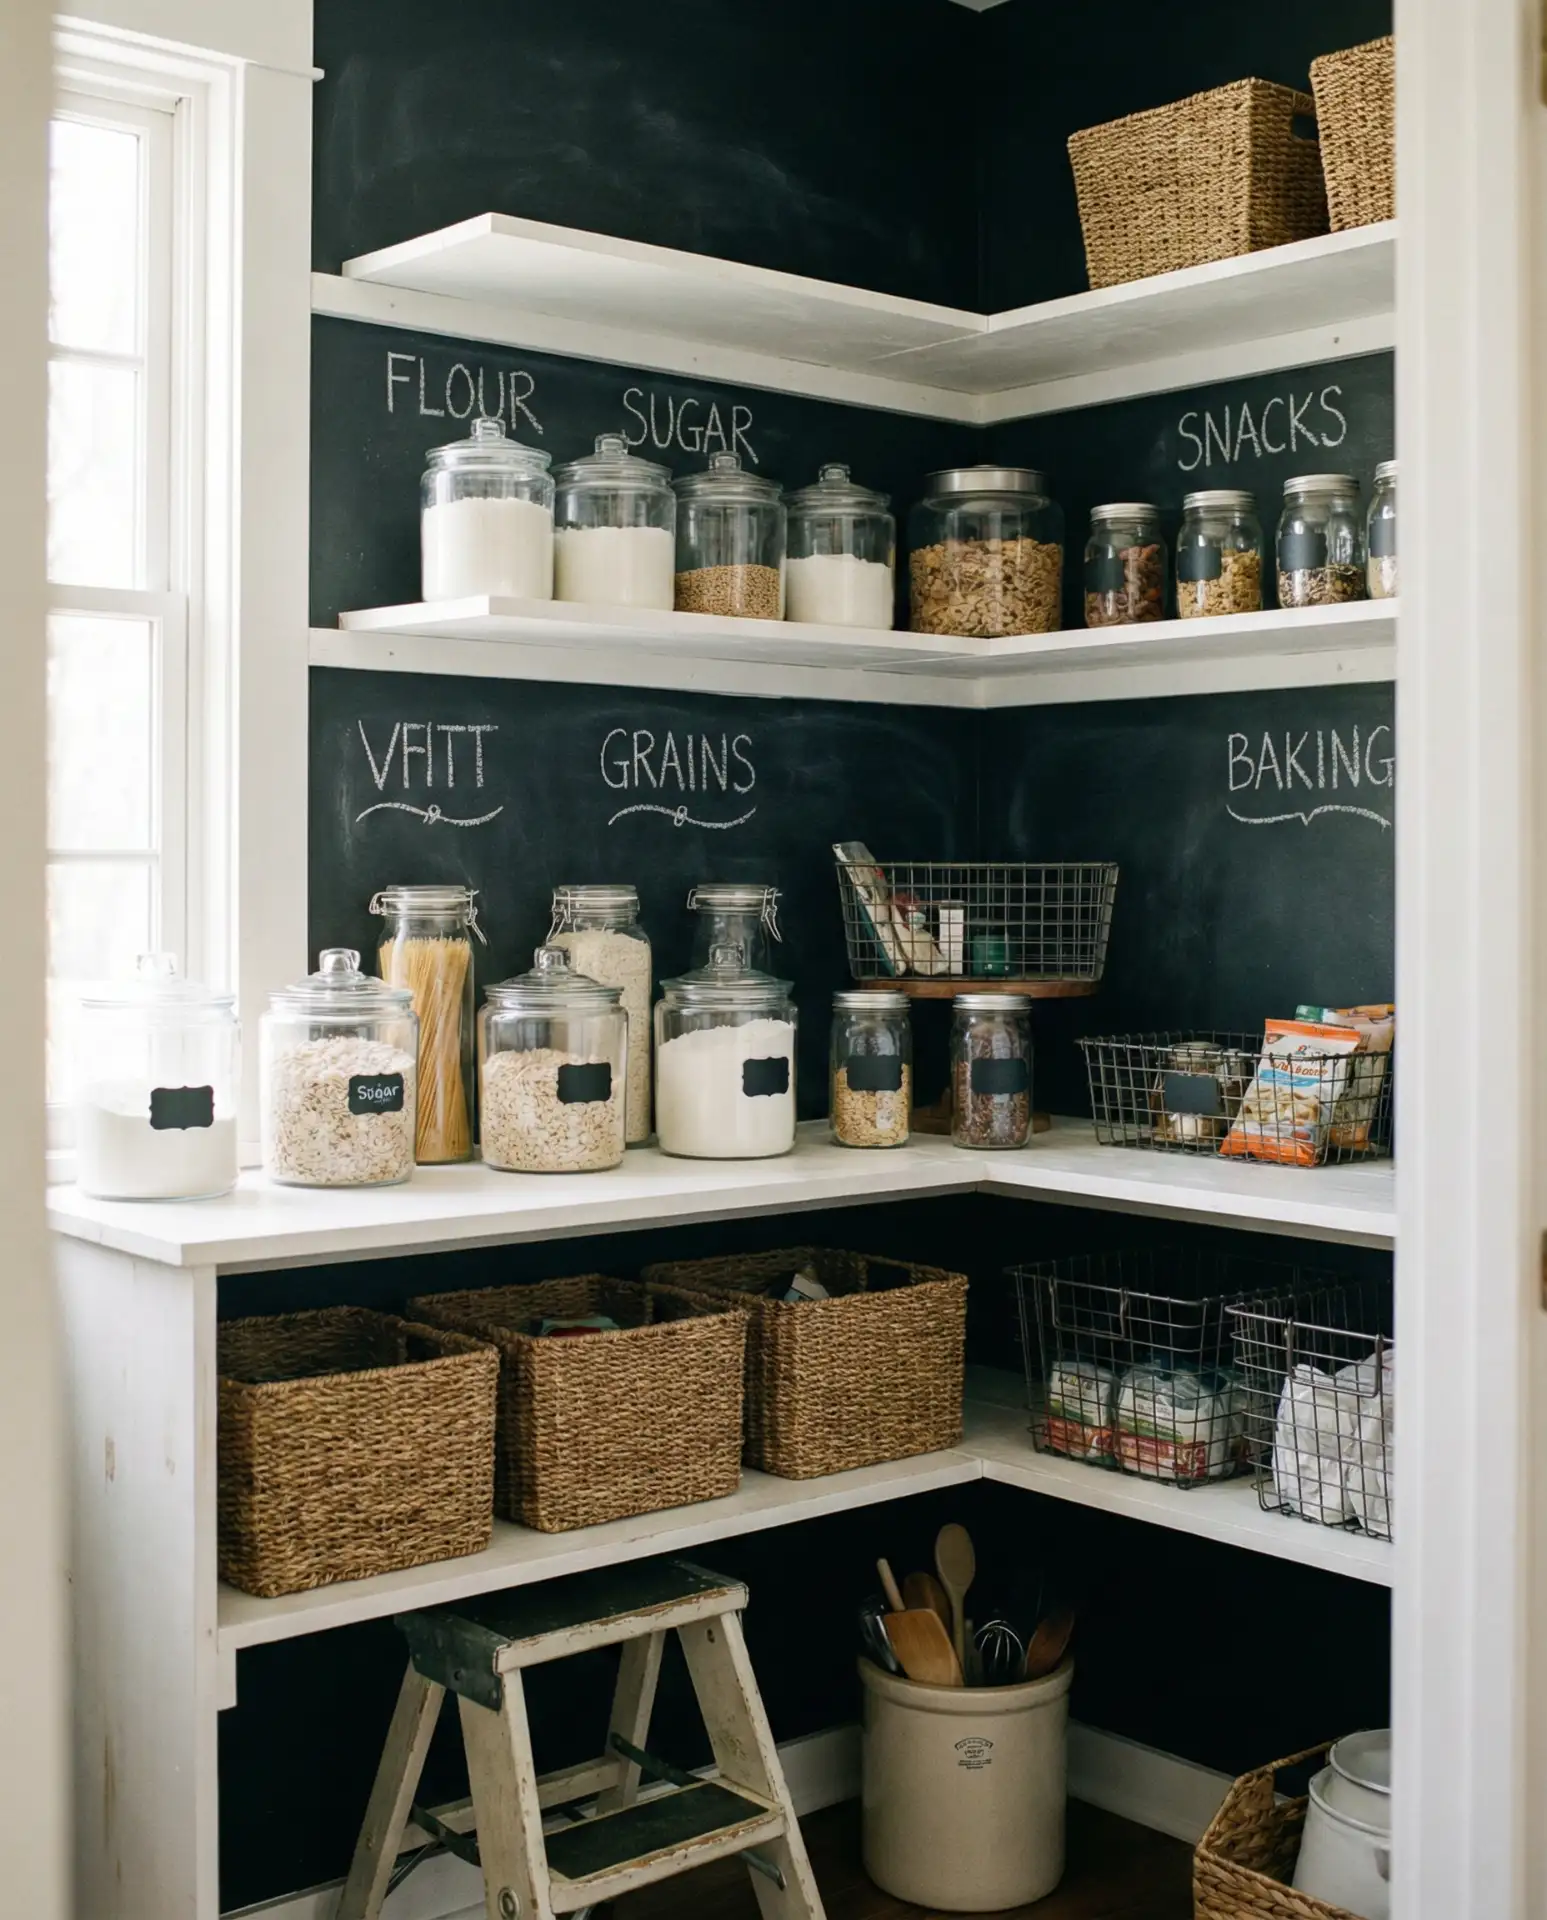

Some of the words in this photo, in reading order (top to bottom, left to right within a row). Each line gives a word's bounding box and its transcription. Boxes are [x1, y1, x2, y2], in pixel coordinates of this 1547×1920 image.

[386, 351, 544, 434] FLOUR
[622, 387, 760, 465] SUGAR
[1177, 384, 1347, 472] SNACKS
[600, 728, 757, 793] GRAINS
[1227, 724, 1395, 791] BAKING
